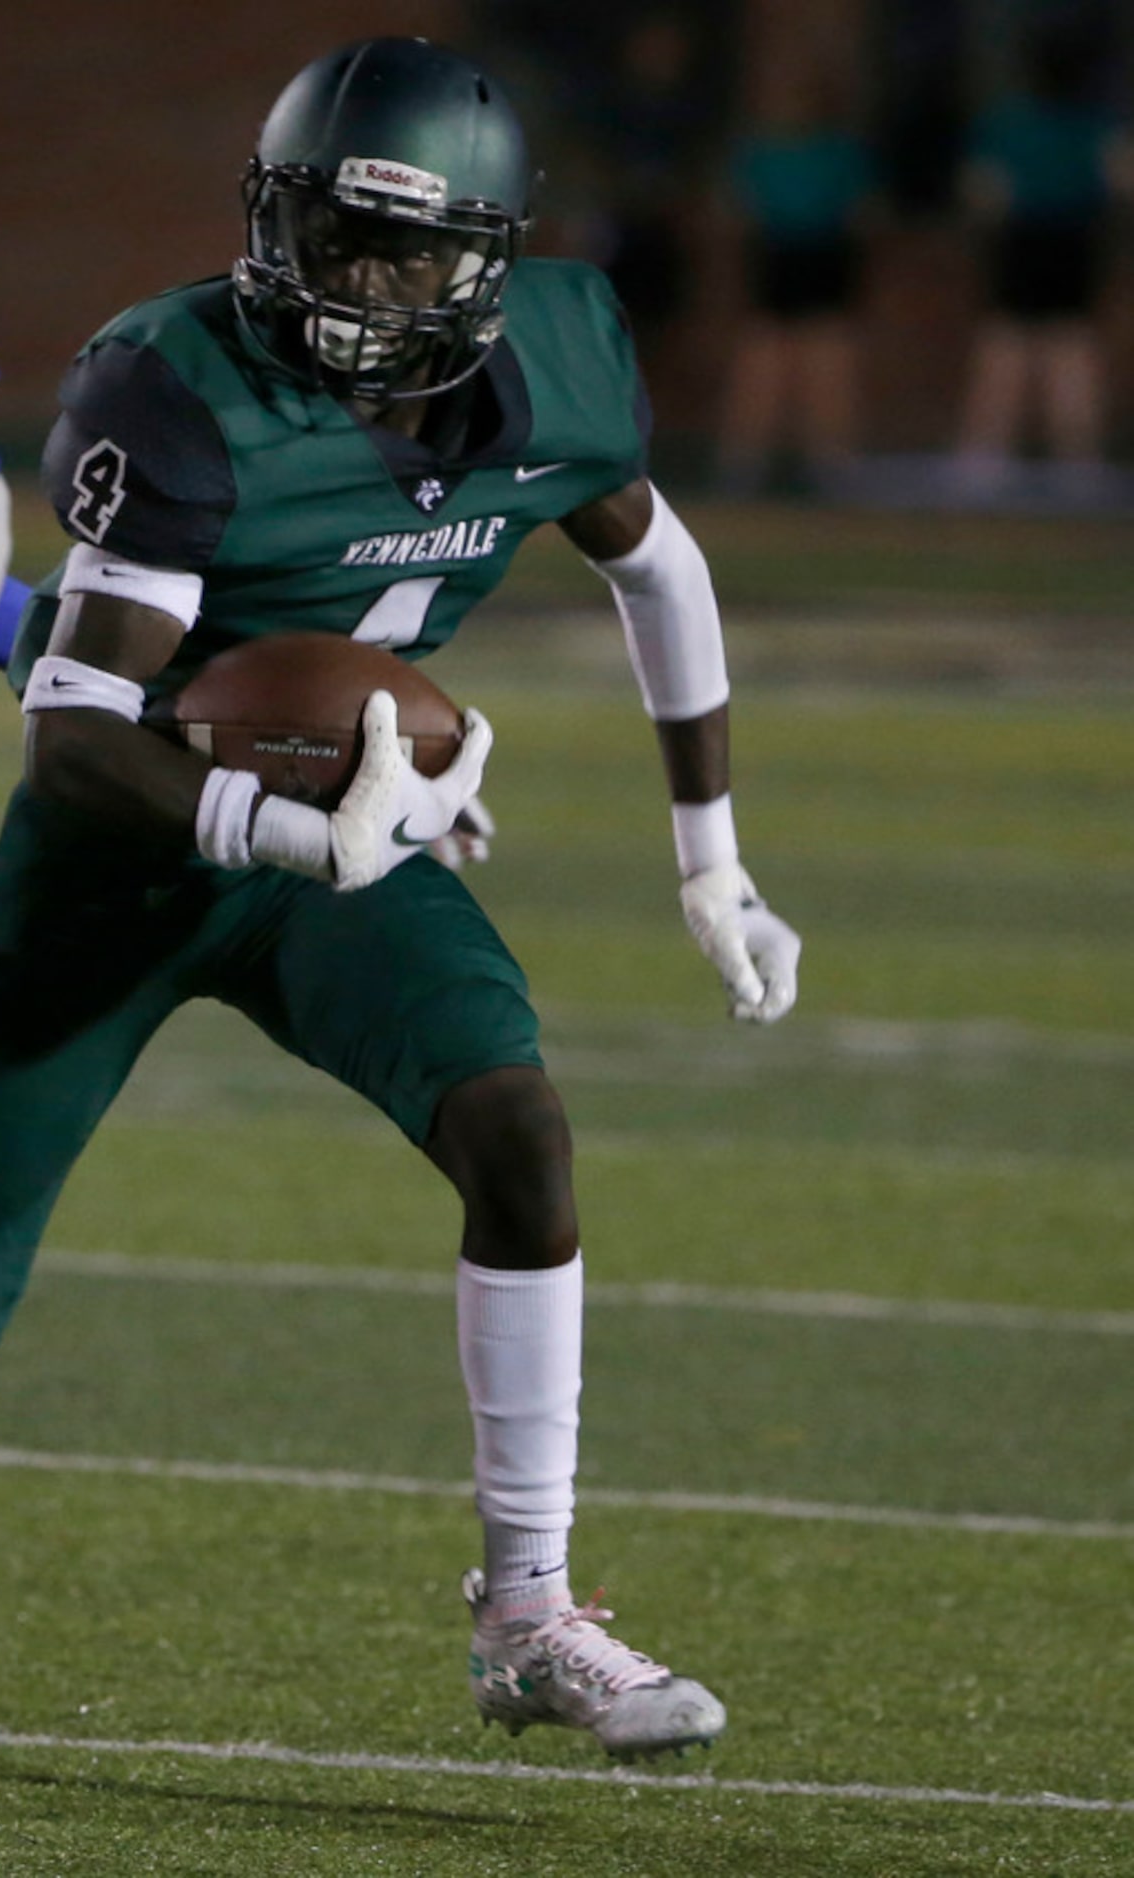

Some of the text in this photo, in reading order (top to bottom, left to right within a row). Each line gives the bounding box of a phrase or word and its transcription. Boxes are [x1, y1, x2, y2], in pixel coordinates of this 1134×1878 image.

[366, 163, 422, 187] Ridde
[68, 438, 126, 544] 4
[340, 516, 506, 565] KENNEDALE
